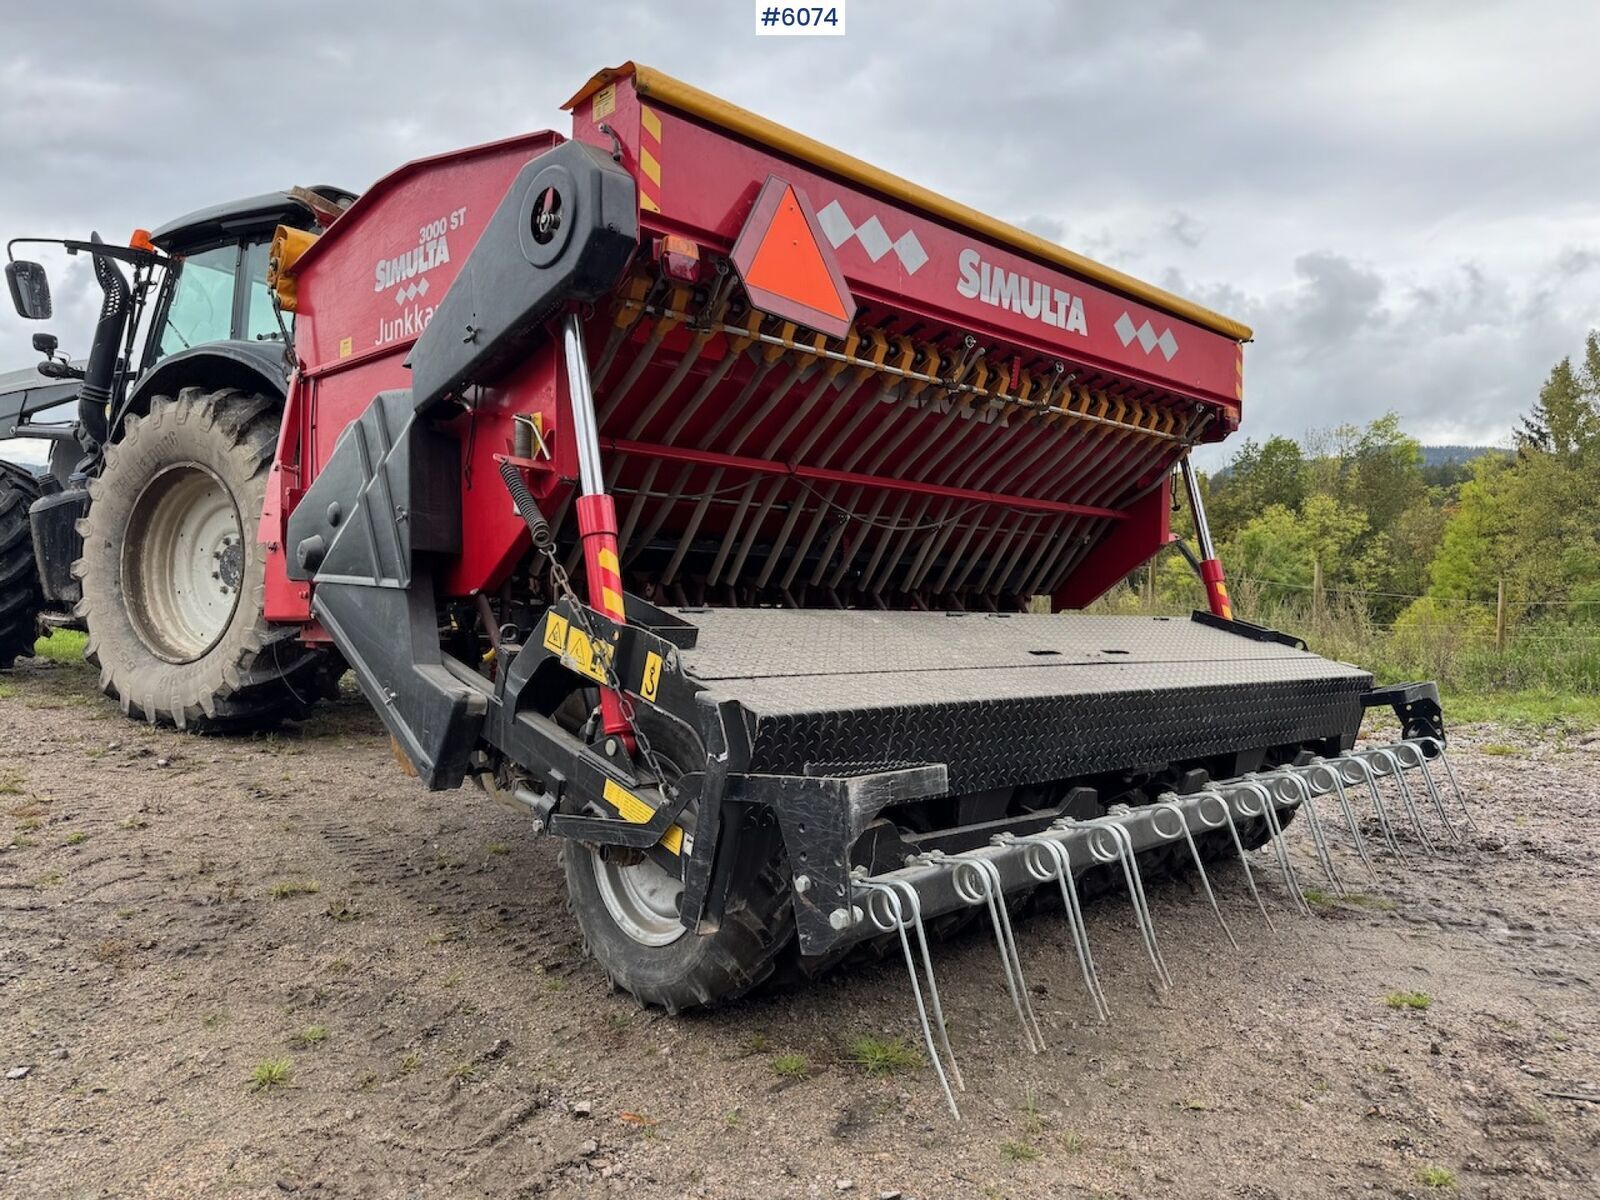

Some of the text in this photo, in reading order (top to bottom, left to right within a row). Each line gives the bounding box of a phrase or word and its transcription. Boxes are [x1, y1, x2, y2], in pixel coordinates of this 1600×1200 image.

[419, 206, 467, 244] 3000 ST
[374, 235, 450, 292] SIMULTA
[956, 248, 1088, 337] SIMULTA
[375, 303, 440, 346] Junkka
